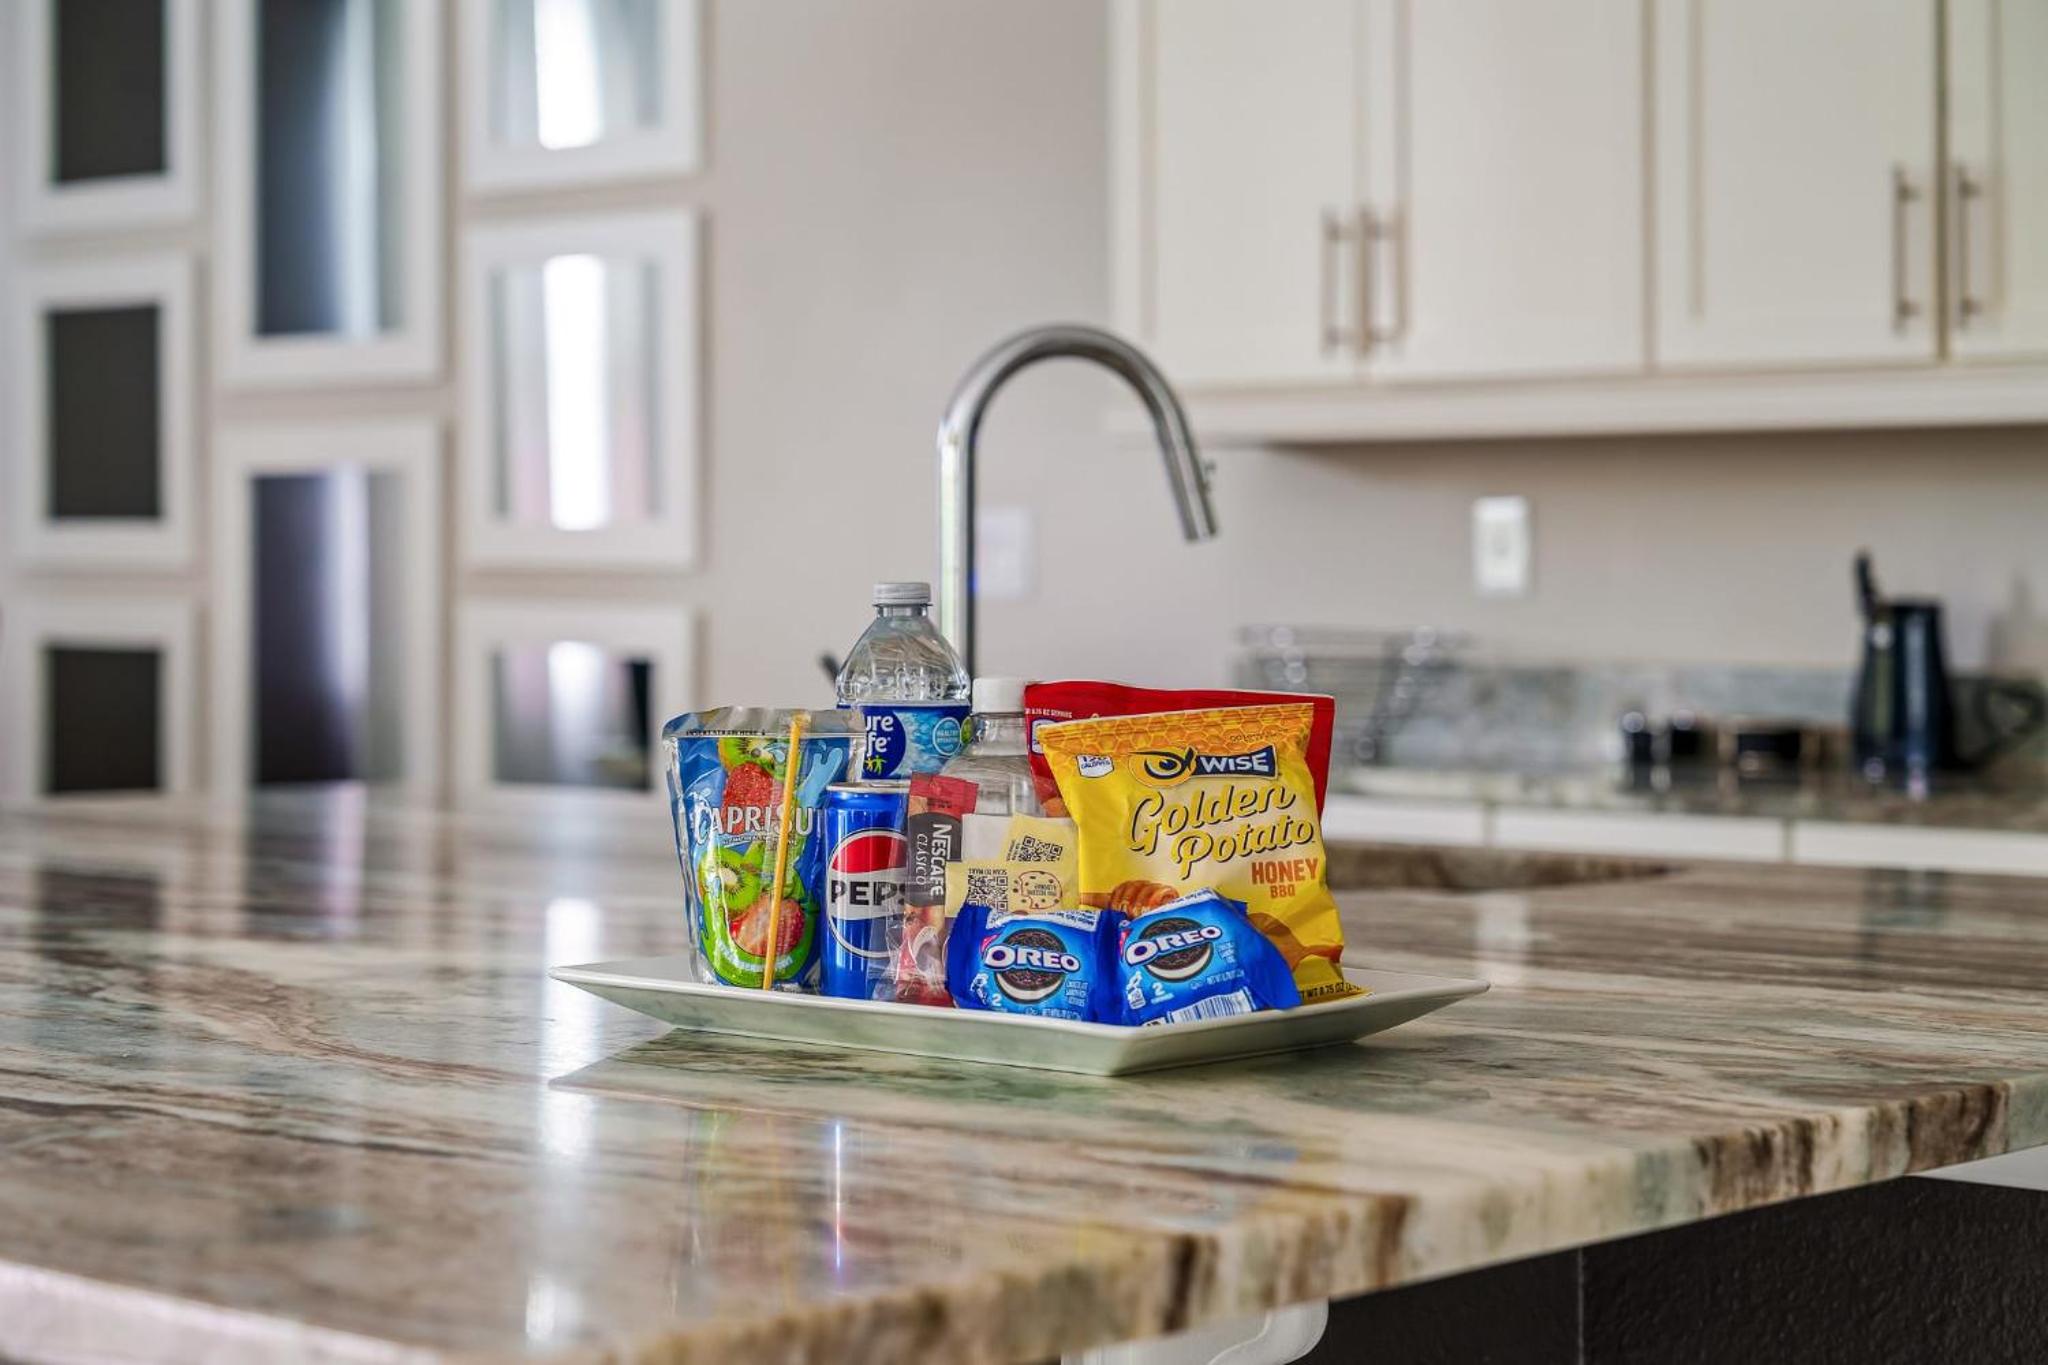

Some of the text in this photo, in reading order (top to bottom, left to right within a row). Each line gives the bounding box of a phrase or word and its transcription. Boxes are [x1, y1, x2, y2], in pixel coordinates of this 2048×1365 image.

[1200, 751, 1269, 773] WISE
[1129, 783, 1297, 857] Golden
[1170, 816, 1314, 881] Potato
[1251, 857, 1319, 885] HONEY
[1270, 883, 1296, 900] BBQ
[984, 943, 1081, 973] OREO
[1125, 925, 1223, 966] OREO
[991, 993, 1002, 1007] 2
[1152, 981, 1166, 996] 2
